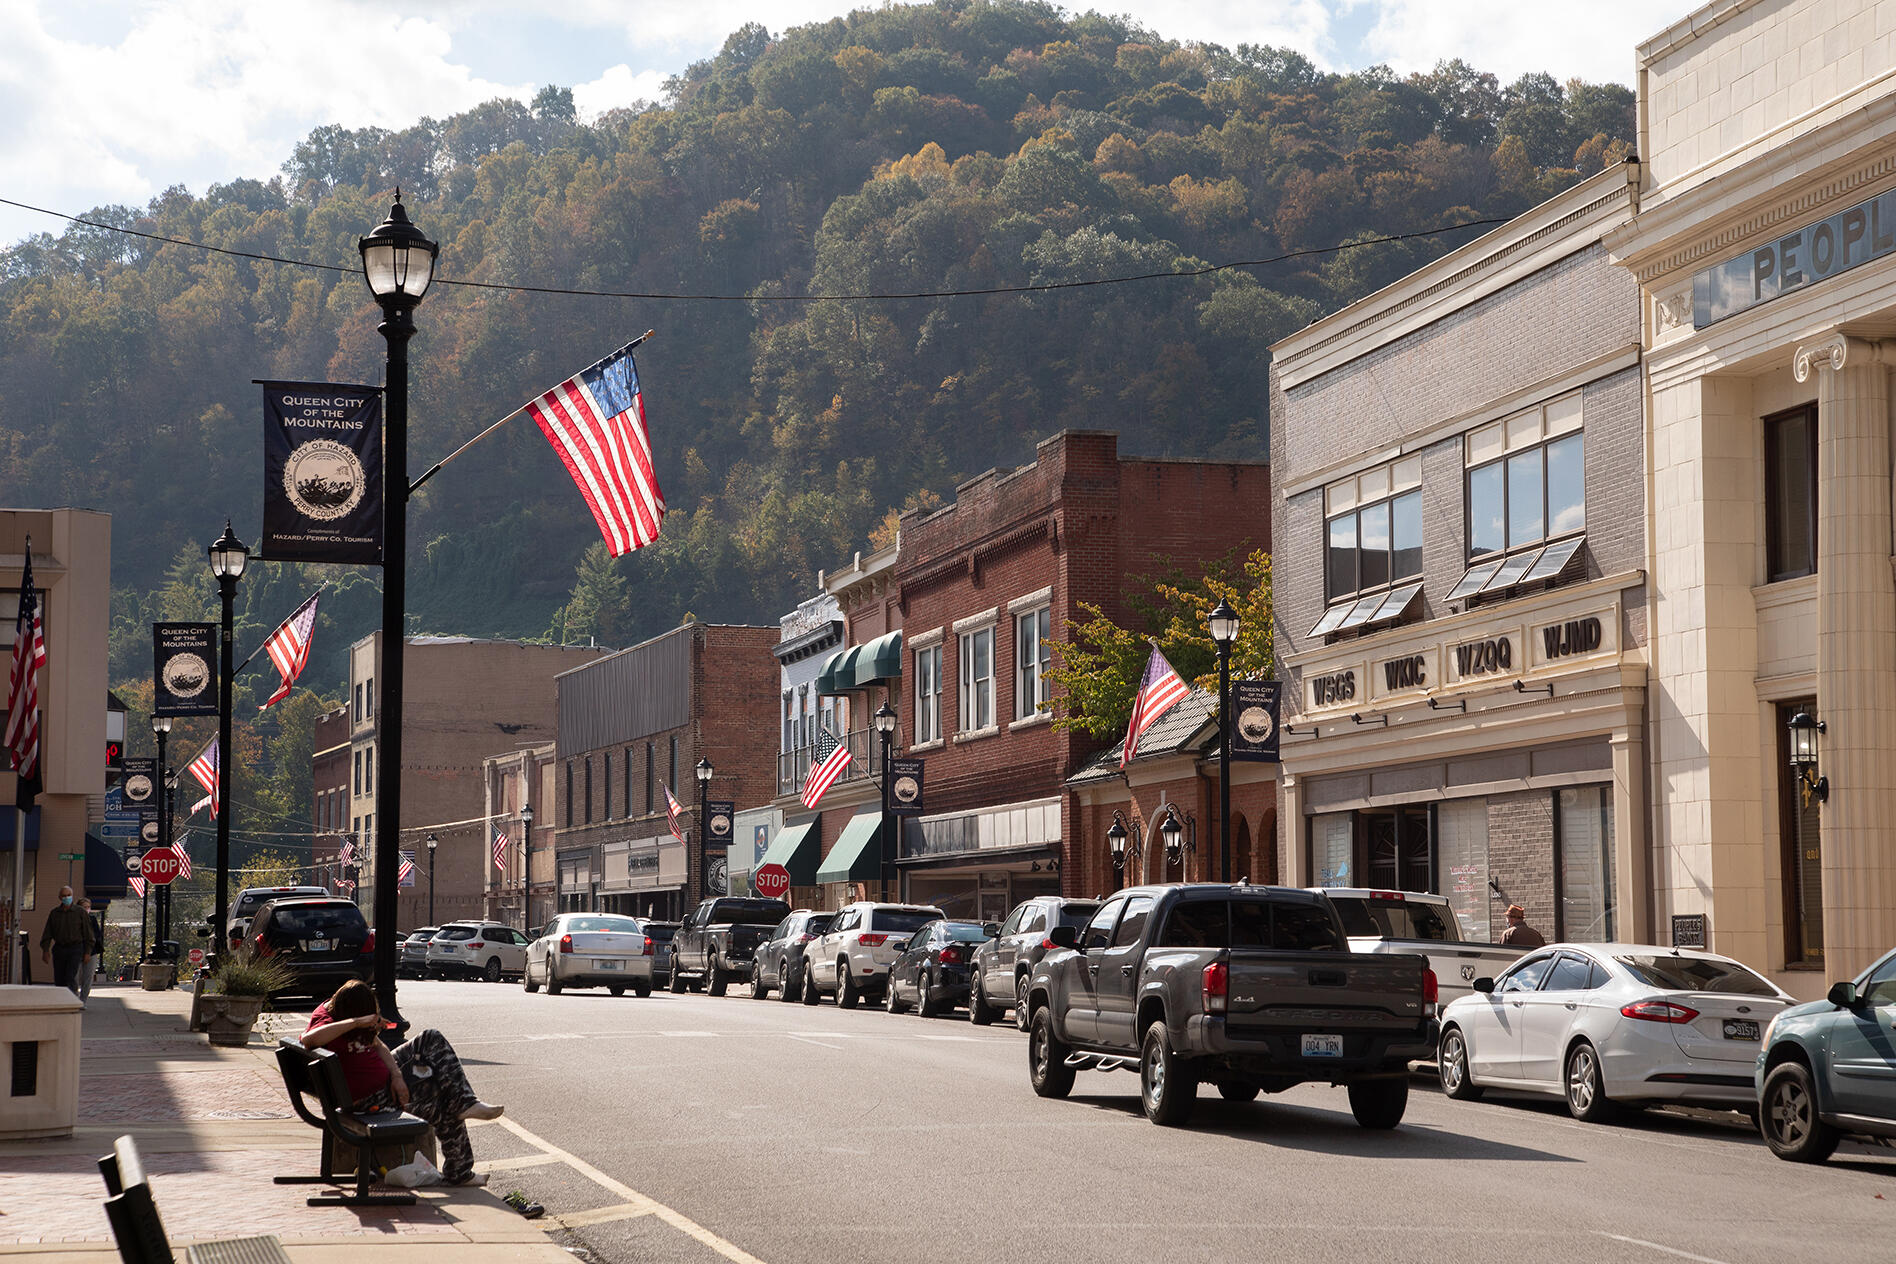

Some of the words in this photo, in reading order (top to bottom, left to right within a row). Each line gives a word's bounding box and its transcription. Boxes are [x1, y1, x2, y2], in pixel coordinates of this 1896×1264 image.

[1754, 200, 1895, 301] PEOPL
[282, 395, 330, 407] QUEEN
[333, 397, 365, 408] CITY
[303, 408, 319, 417] OF
[321, 409, 345, 418] THE
[284, 417, 364, 430] MOUNTAINS
[292, 447, 308, 463] CITY
[311, 442, 323, 450] OF
[327, 443, 357, 466] HAZARD
[294, 497, 315, 514] PERRY
[161, 628, 189, 636] QUEEN
[190, 627, 208, 635] CITY
[162, 640, 208, 648] MOUNTAINS
[1312, 670, 1355, 706] WSGS
[1384, 655, 1425, 691] WKIC
[1456, 636, 1512, 677] WZQQ
[1543, 617, 1601, 660] WJMD
[143, 859, 178, 873] STOP
[757, 873, 788, 888] STOP
[1305, 1040, 1320, 1051] 004
[1324, 1040, 1339, 1051] YRN
